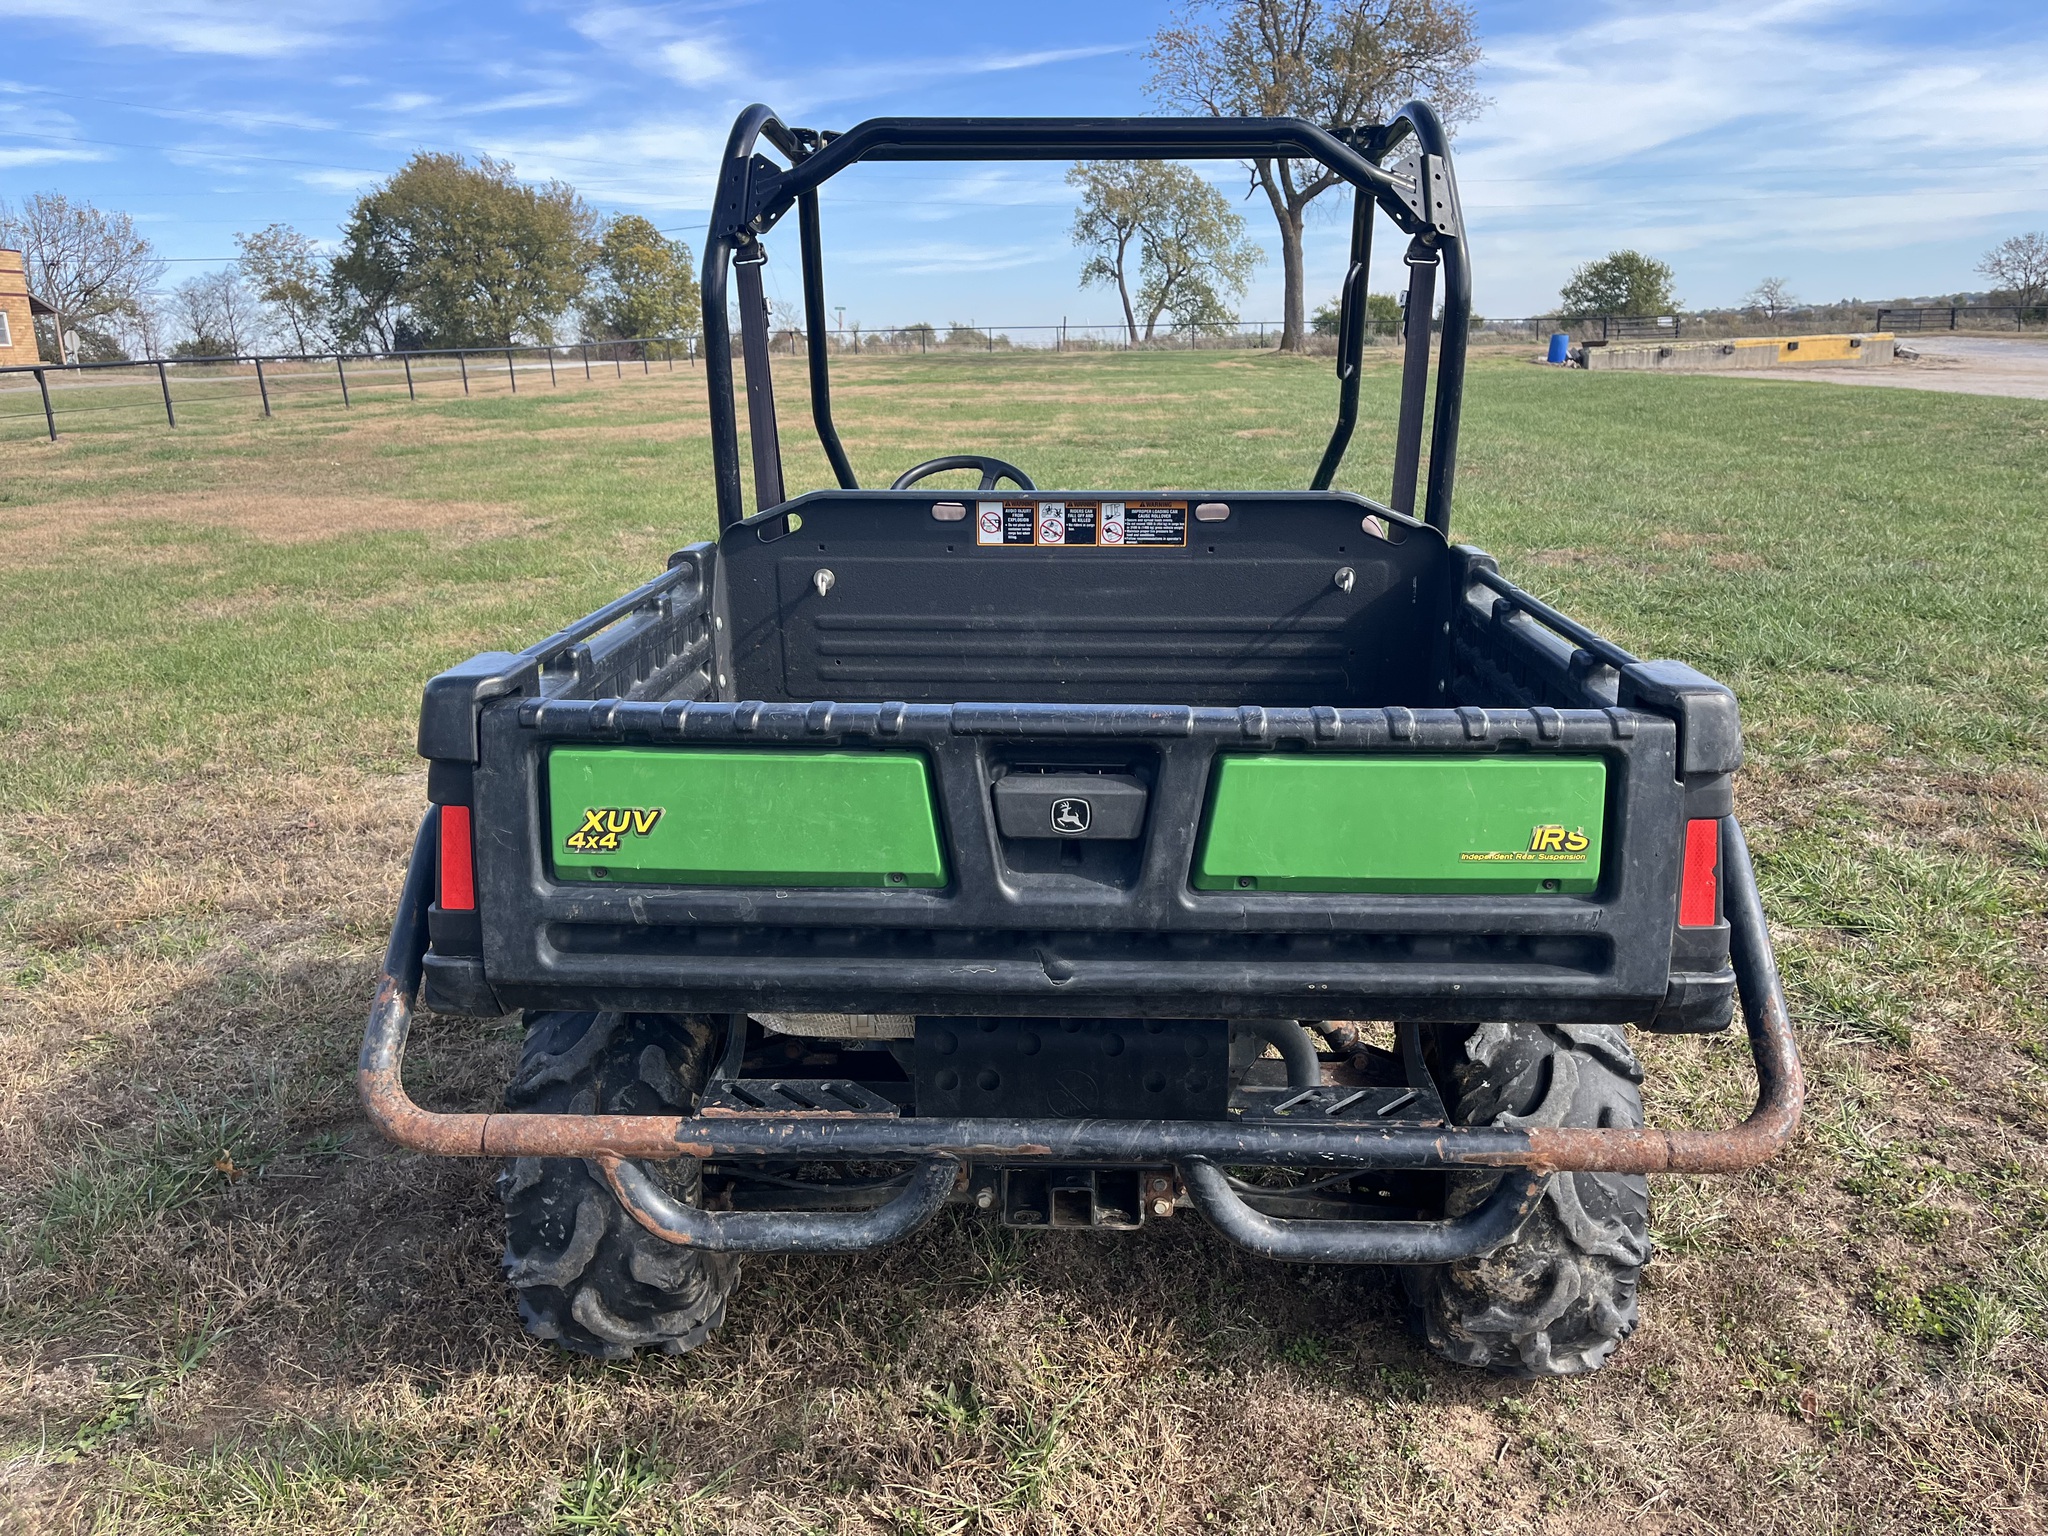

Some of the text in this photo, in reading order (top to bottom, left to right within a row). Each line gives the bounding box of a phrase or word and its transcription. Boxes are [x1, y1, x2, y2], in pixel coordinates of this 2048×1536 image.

[579, 810, 660, 833] XUV
[567, 832, 618, 849] 4x4
[1531, 828, 1589, 851] IRS
[1461, 853, 1513, 861] Independent
[1538, 853, 1586, 861] Suspension
